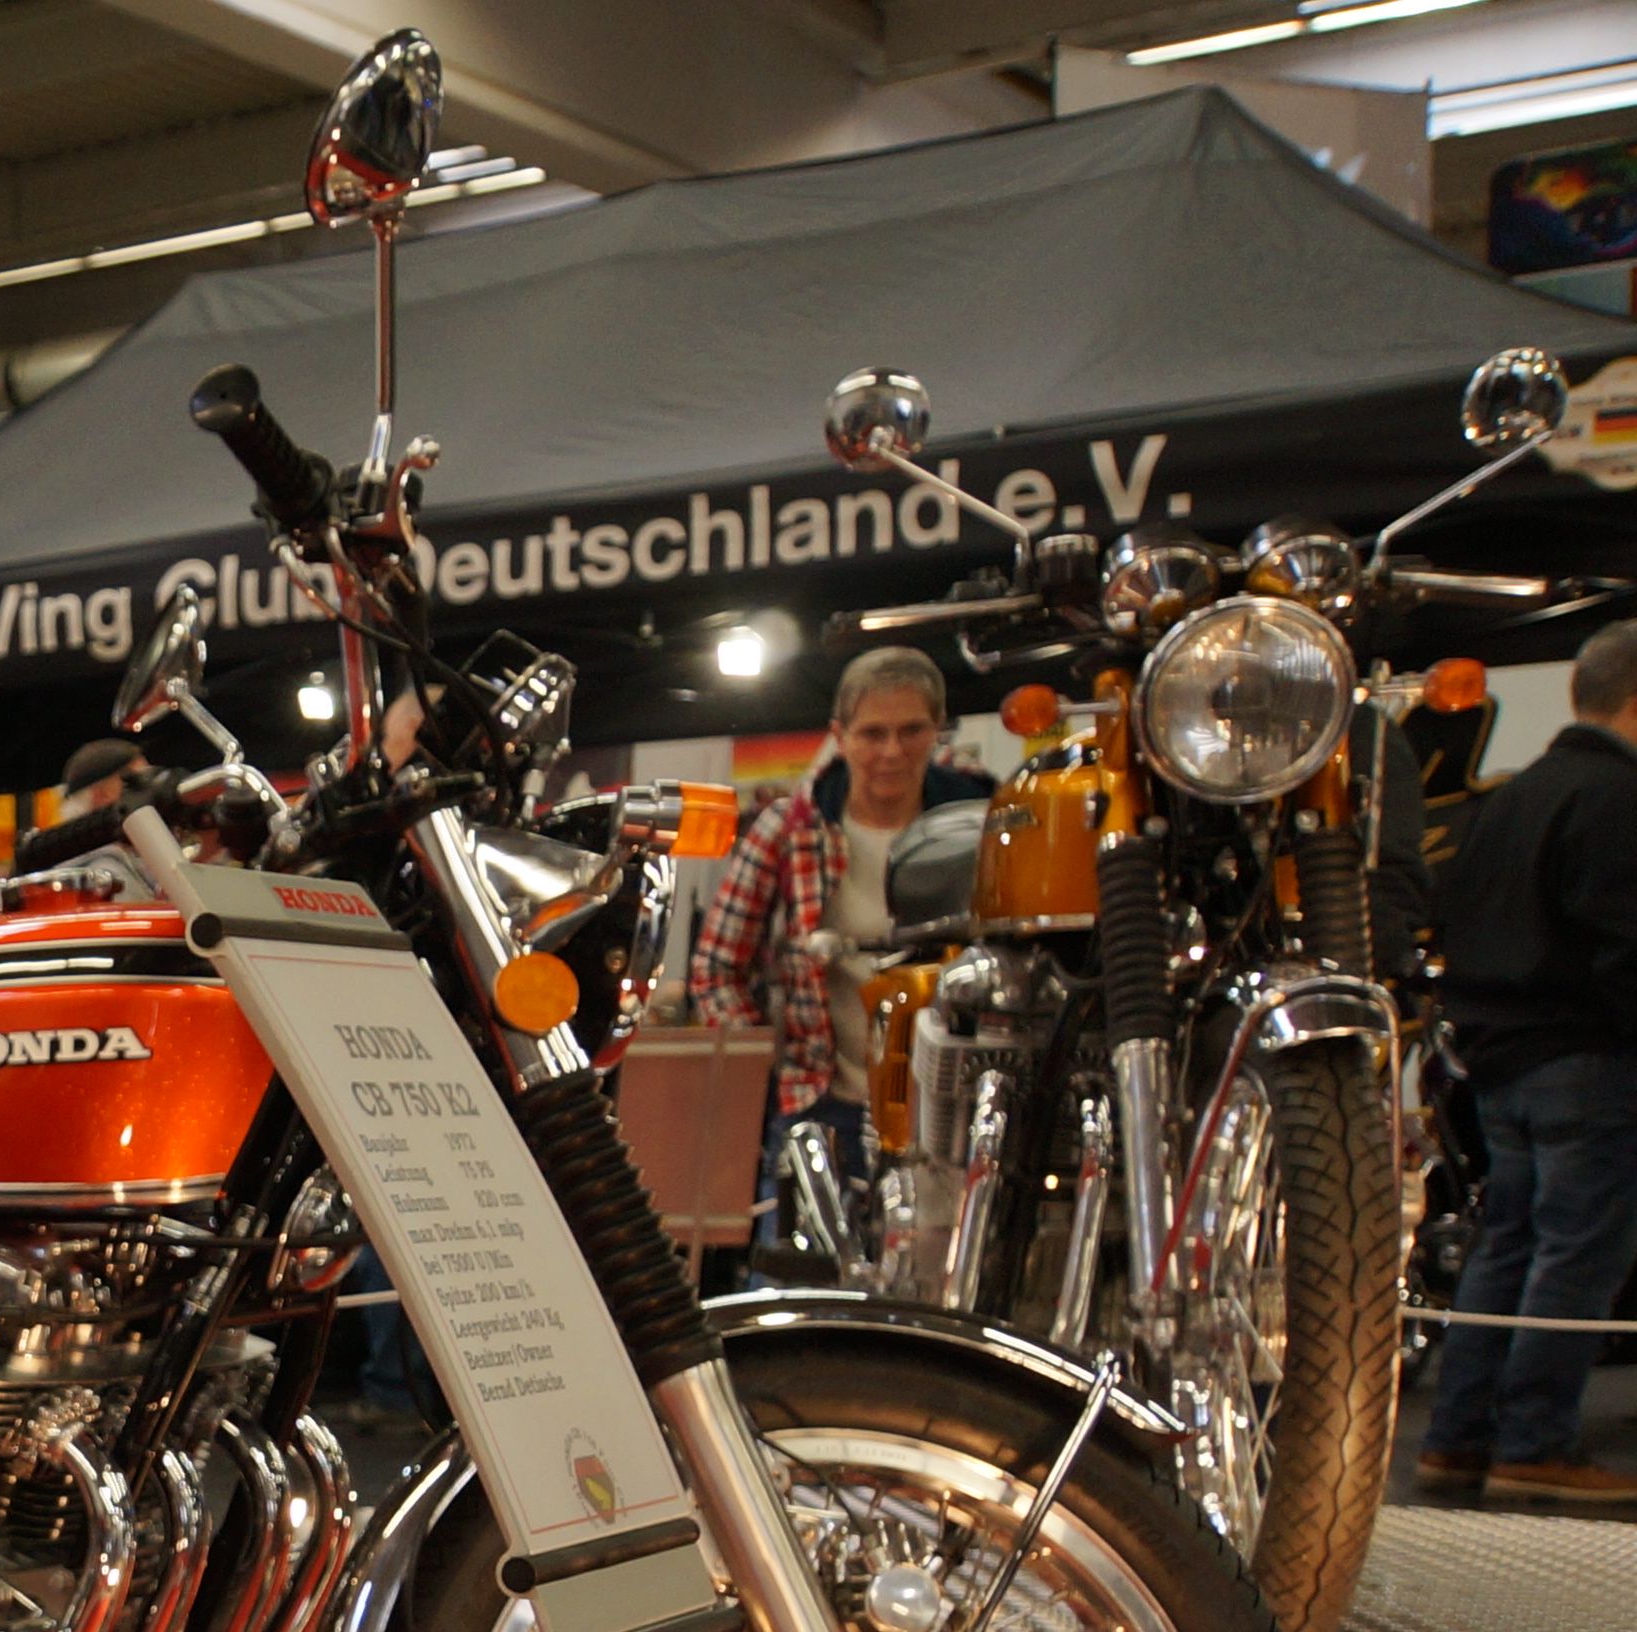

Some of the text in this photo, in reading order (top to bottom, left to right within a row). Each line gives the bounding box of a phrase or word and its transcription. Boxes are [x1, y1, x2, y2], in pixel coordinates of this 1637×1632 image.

[996, 433, 1193, 533] e.V.
[273, 886, 378, 917] HONDA
[334, 1024, 432, 1061] HONDA
[351, 1081, 481, 1117] CB 750 K2
[408, 1227, 438, 1244] max
[421, 1255, 444, 1275] bei
[436, 1286, 477, 1312] Spitze
[450, 1312, 523, 1341] Leergewicht
[477, 1378, 516, 1402] Bernd
